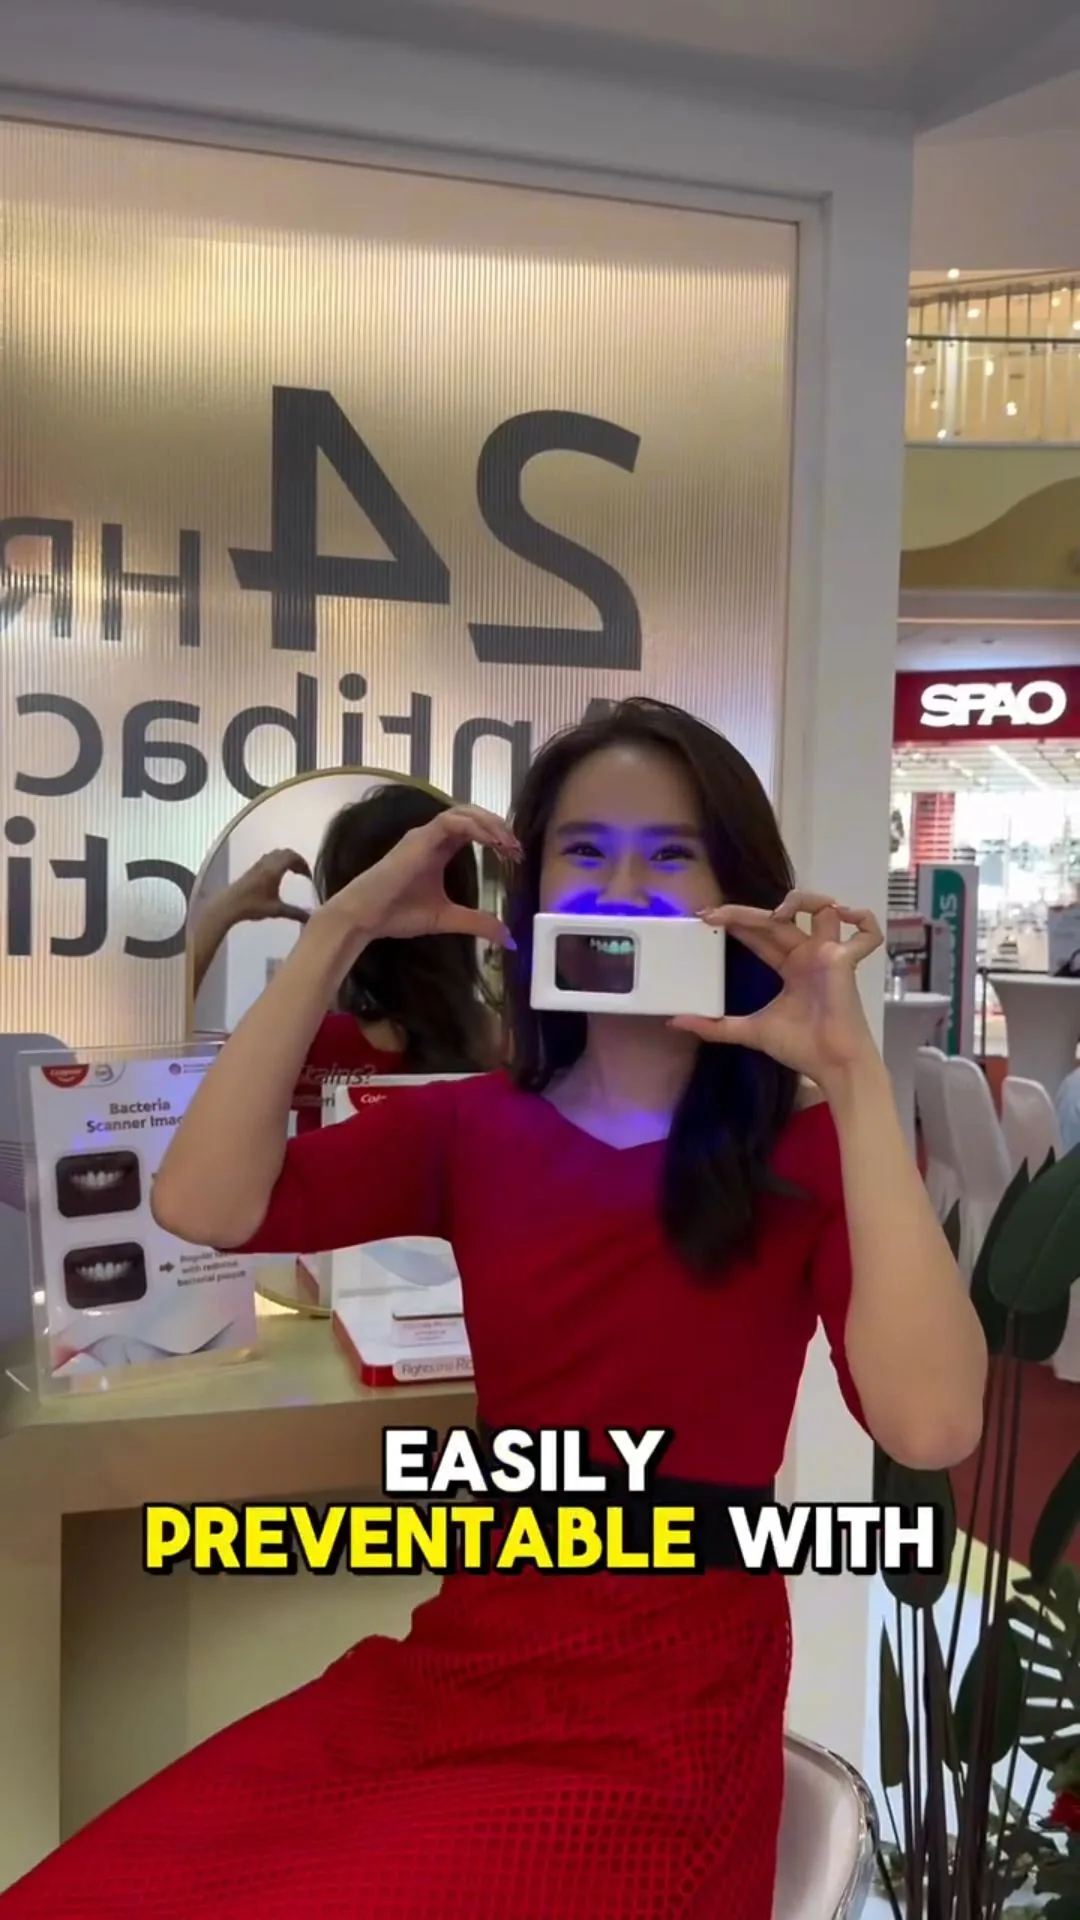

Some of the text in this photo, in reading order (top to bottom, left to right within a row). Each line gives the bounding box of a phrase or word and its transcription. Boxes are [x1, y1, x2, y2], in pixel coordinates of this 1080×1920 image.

[919, 680, 1067, 728] SPAO
[109, 1098, 171, 1115] Bacteria
[86, 1117, 146, 1133] Scanner
